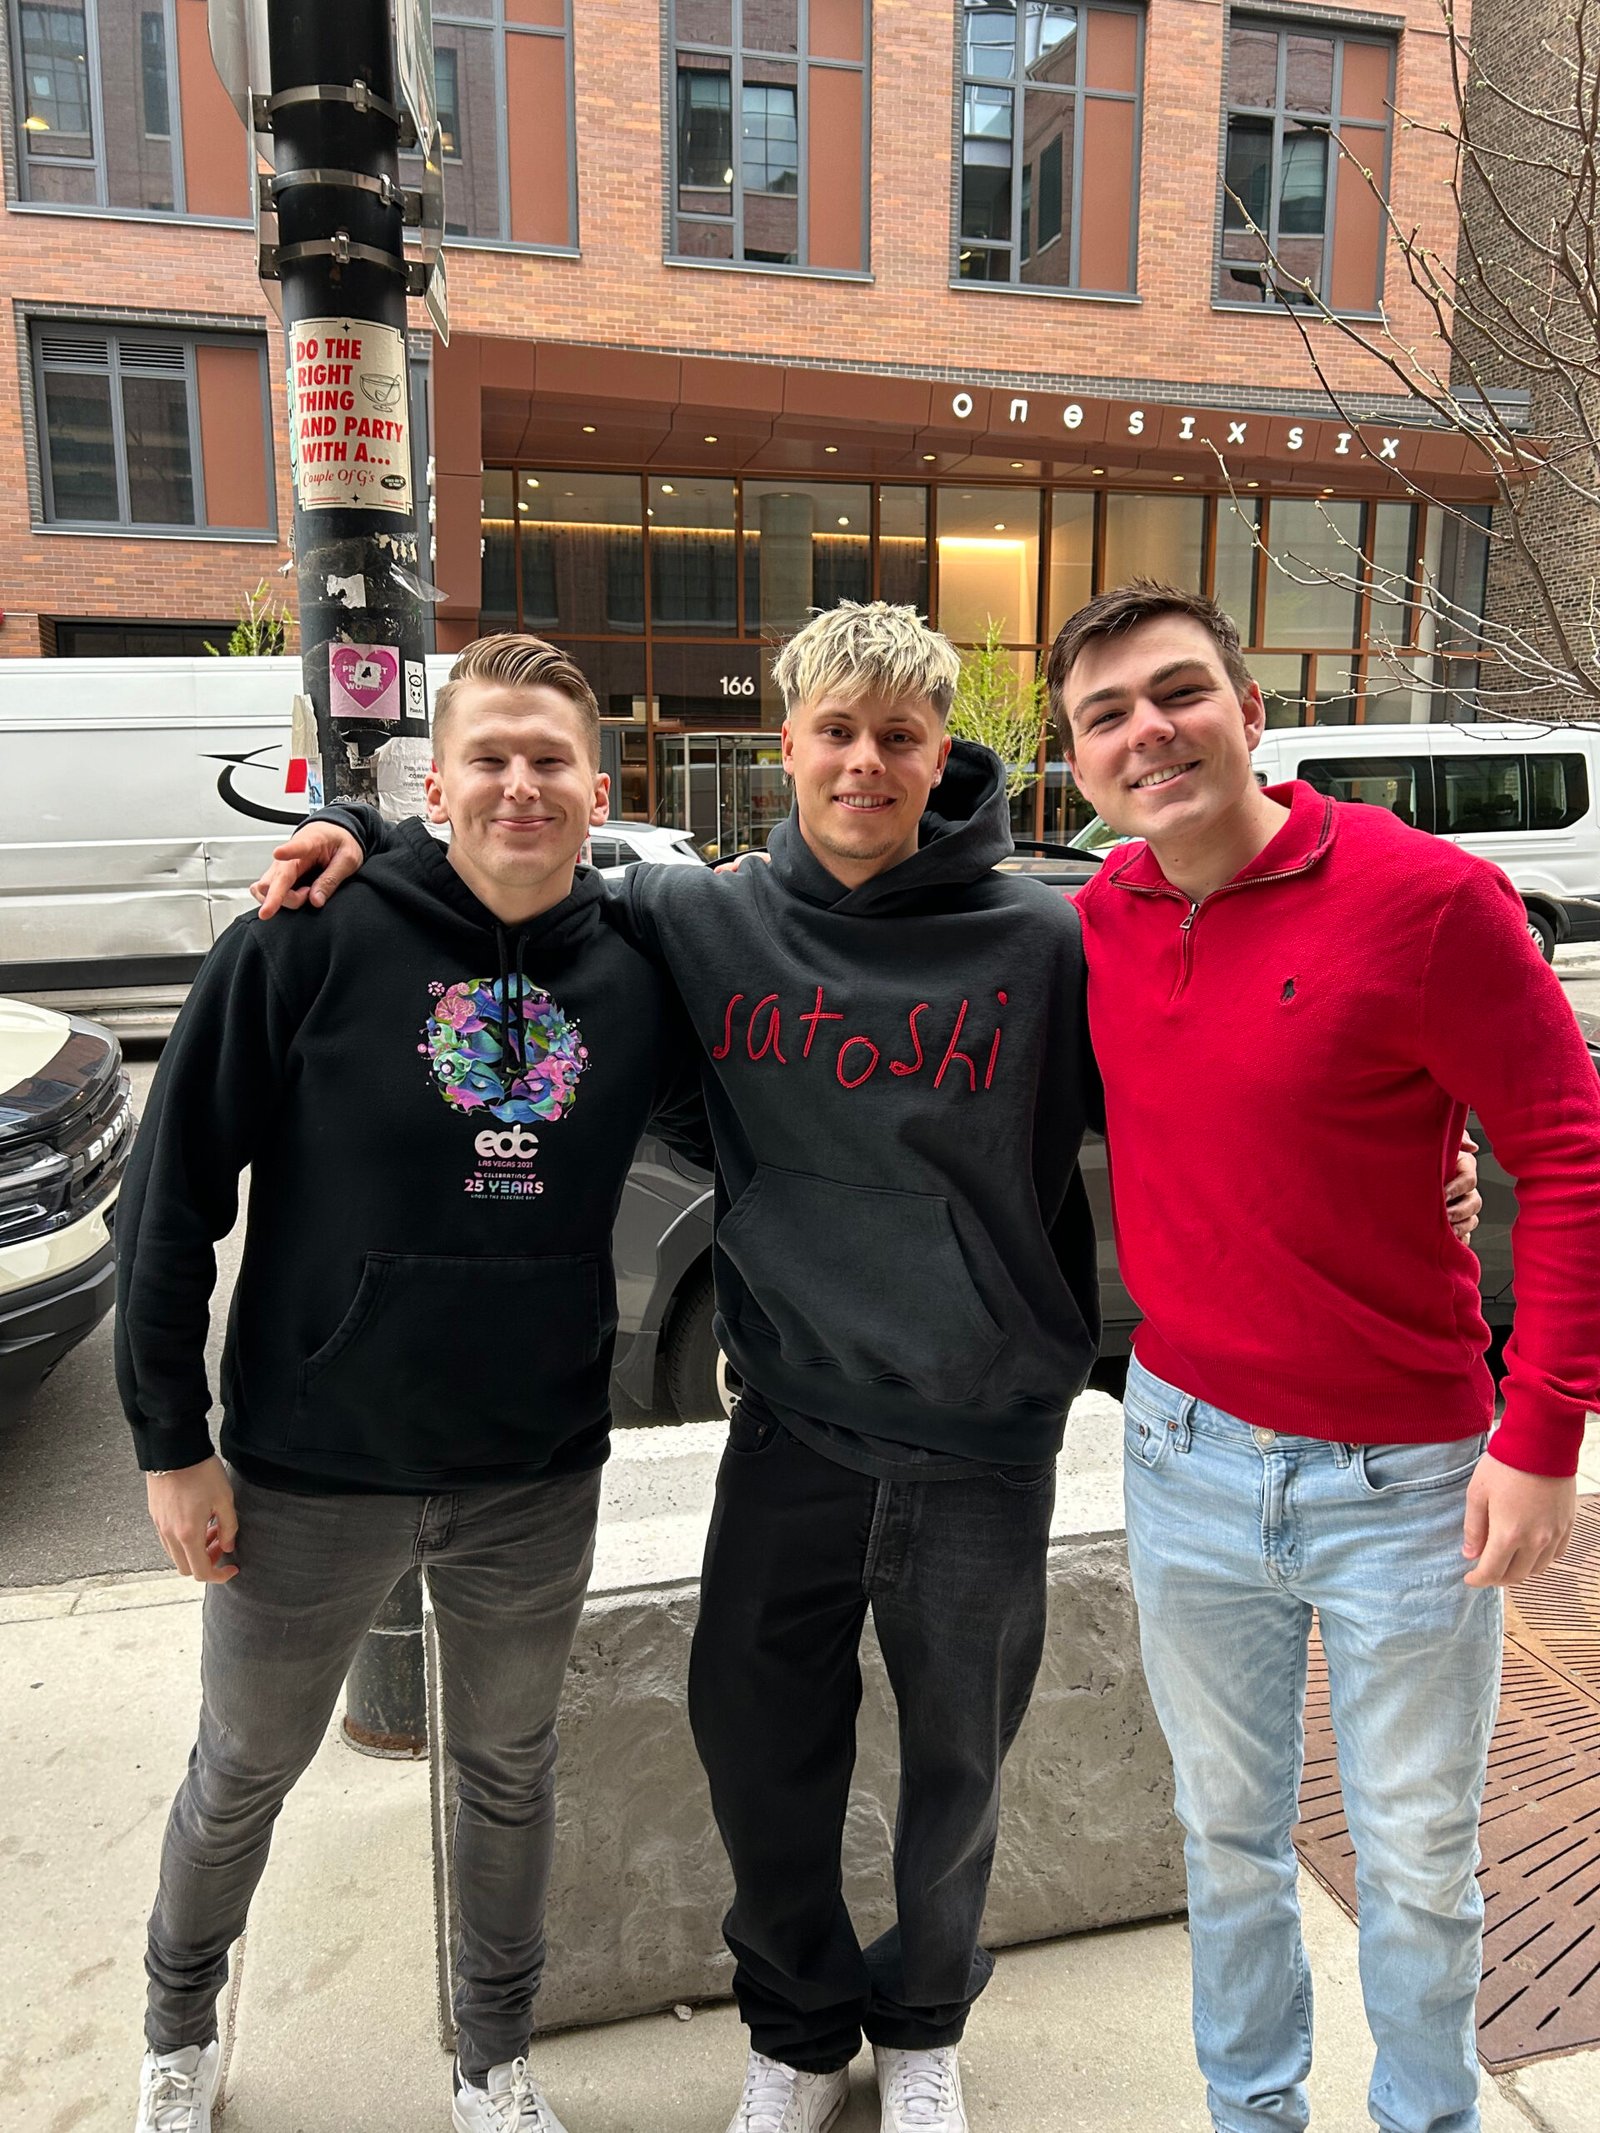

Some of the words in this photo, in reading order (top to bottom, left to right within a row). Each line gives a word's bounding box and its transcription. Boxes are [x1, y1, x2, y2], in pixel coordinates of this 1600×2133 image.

[296, 338, 318, 362] DO
[325, 338, 362, 361] THE
[297, 364, 353, 388] RIGHT
[299, 390, 355, 414] THING
[300, 416, 337, 440] AND
[344, 416, 404, 443] PARTY
[1127, 410, 1248, 445] SIX
[1287, 426, 1401, 460] SIX
[302, 441, 347, 464] WITH
[354, 442, 390, 465] A...
[303, 469, 334, 488] Couple
[337, 468, 356, 486] Of
[356, 469, 376, 487] G's
[720, 675, 755, 696] 166
[712, 985, 1008, 1092] satoshi
[474, 1123, 539, 1159] edc
[493, 1160, 516, 1168] VEGAS
[464, 1178, 485, 1192] 25
[488, 1180, 544, 1194] YEARS
